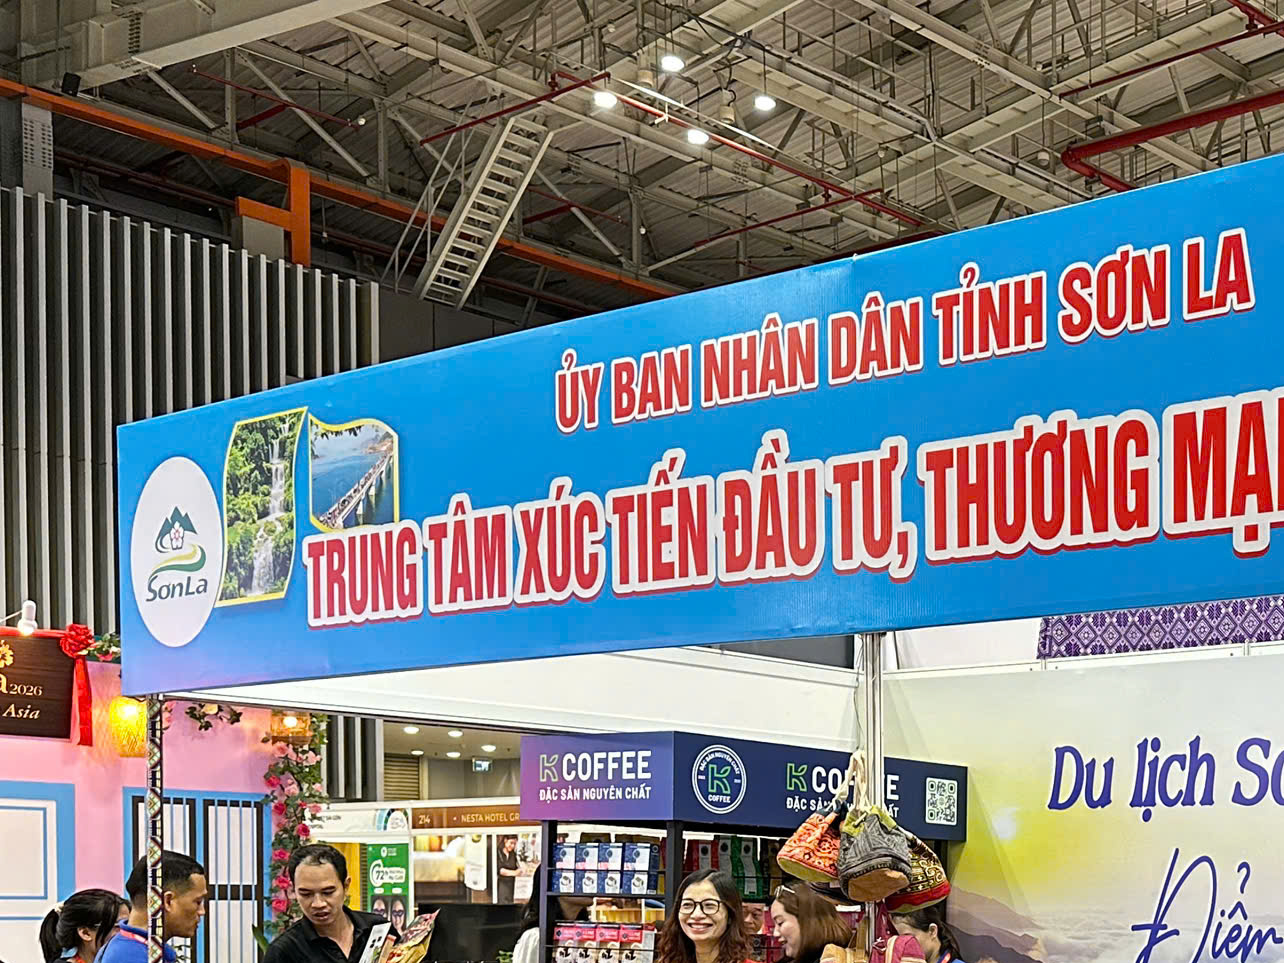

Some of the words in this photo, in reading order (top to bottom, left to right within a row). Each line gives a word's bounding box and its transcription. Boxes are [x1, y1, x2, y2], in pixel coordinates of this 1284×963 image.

[557, 350, 601, 428] ỦY
[613, 348, 689, 418] BAN
[703, 317, 816, 402] NHÂN
[831, 294, 921, 379] DÂN
[935, 267, 1043, 360] TỈNH
[1061, 248, 1168, 338] SƠN
[1186, 232, 1252, 318] LA
[306, 526, 418, 625] TRUNG
[428, 500, 509, 614] TÂM
[519, 483, 602, 599] XÚC
[611, 456, 714, 594] TIẾN
[720, 437, 817, 584] ĐẦU
[828, 444, 911, 580] TƯ,
[925, 418, 1157, 563] THƯƠNG
[9, 683, 43, 696] 2026
[2, 703, 40, 719] Asia
[562, 750, 652, 781] COFFEE
[812, 766, 899, 801] COE
[1047, 746, 1113, 810] Du
[1129, 735, 1216, 822] lịch
[539, 787, 559, 804] ĐẶC
[561, 785, 580, 801] SẢN
[583, 784, 623, 800] NGUYÊN
[625, 782, 652, 800] CHẤT
[708, 794, 731, 803] COFFEE
[786, 795, 808, 813] ĐẶC
[461, 814, 483, 823] NESTA
[485, 813, 508, 823] HOTEL
